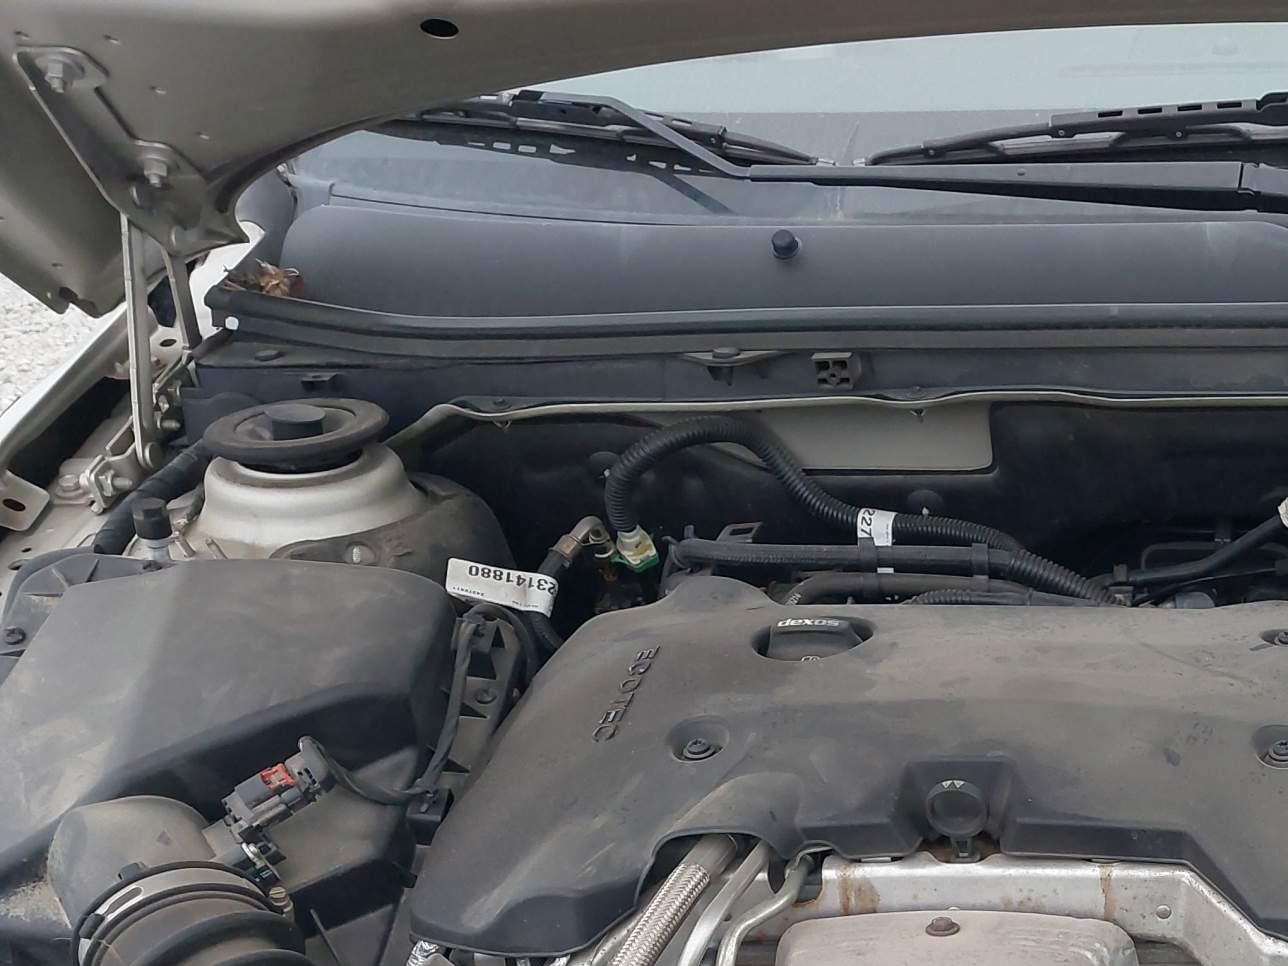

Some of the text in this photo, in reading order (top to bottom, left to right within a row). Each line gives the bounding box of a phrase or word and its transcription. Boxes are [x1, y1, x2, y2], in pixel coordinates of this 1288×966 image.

[468, 565, 557, 595] 23141880
[777, 618, 840, 627] dexos
[591, 645, 661, 743] ECOTEC
